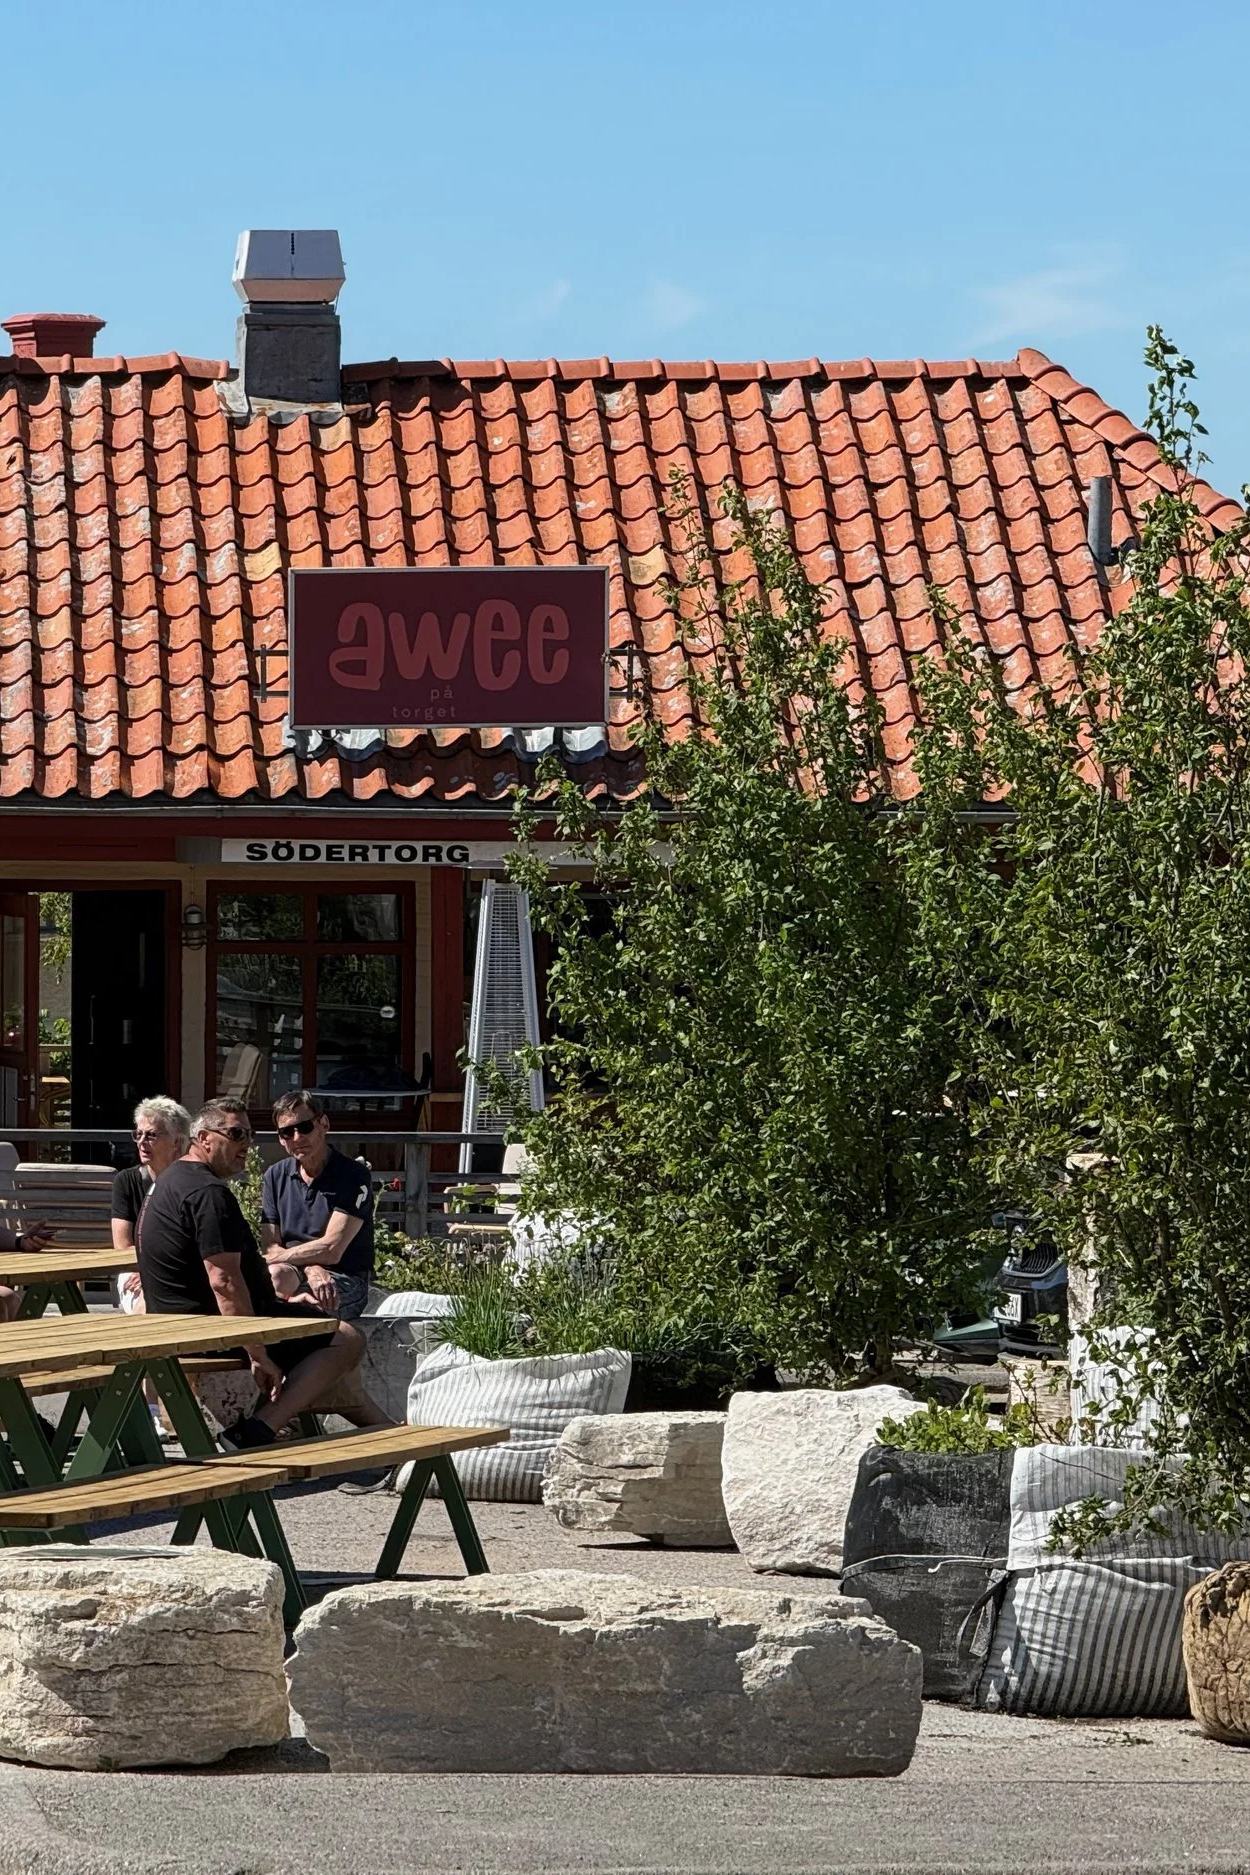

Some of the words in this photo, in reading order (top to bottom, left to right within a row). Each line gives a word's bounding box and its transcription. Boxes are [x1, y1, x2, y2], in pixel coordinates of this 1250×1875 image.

[330, 600, 569, 691] awee
[431, 684, 453, 702] på
[392, 706, 455, 721] torget
[246, 841, 469, 863] SÖDERTORG
